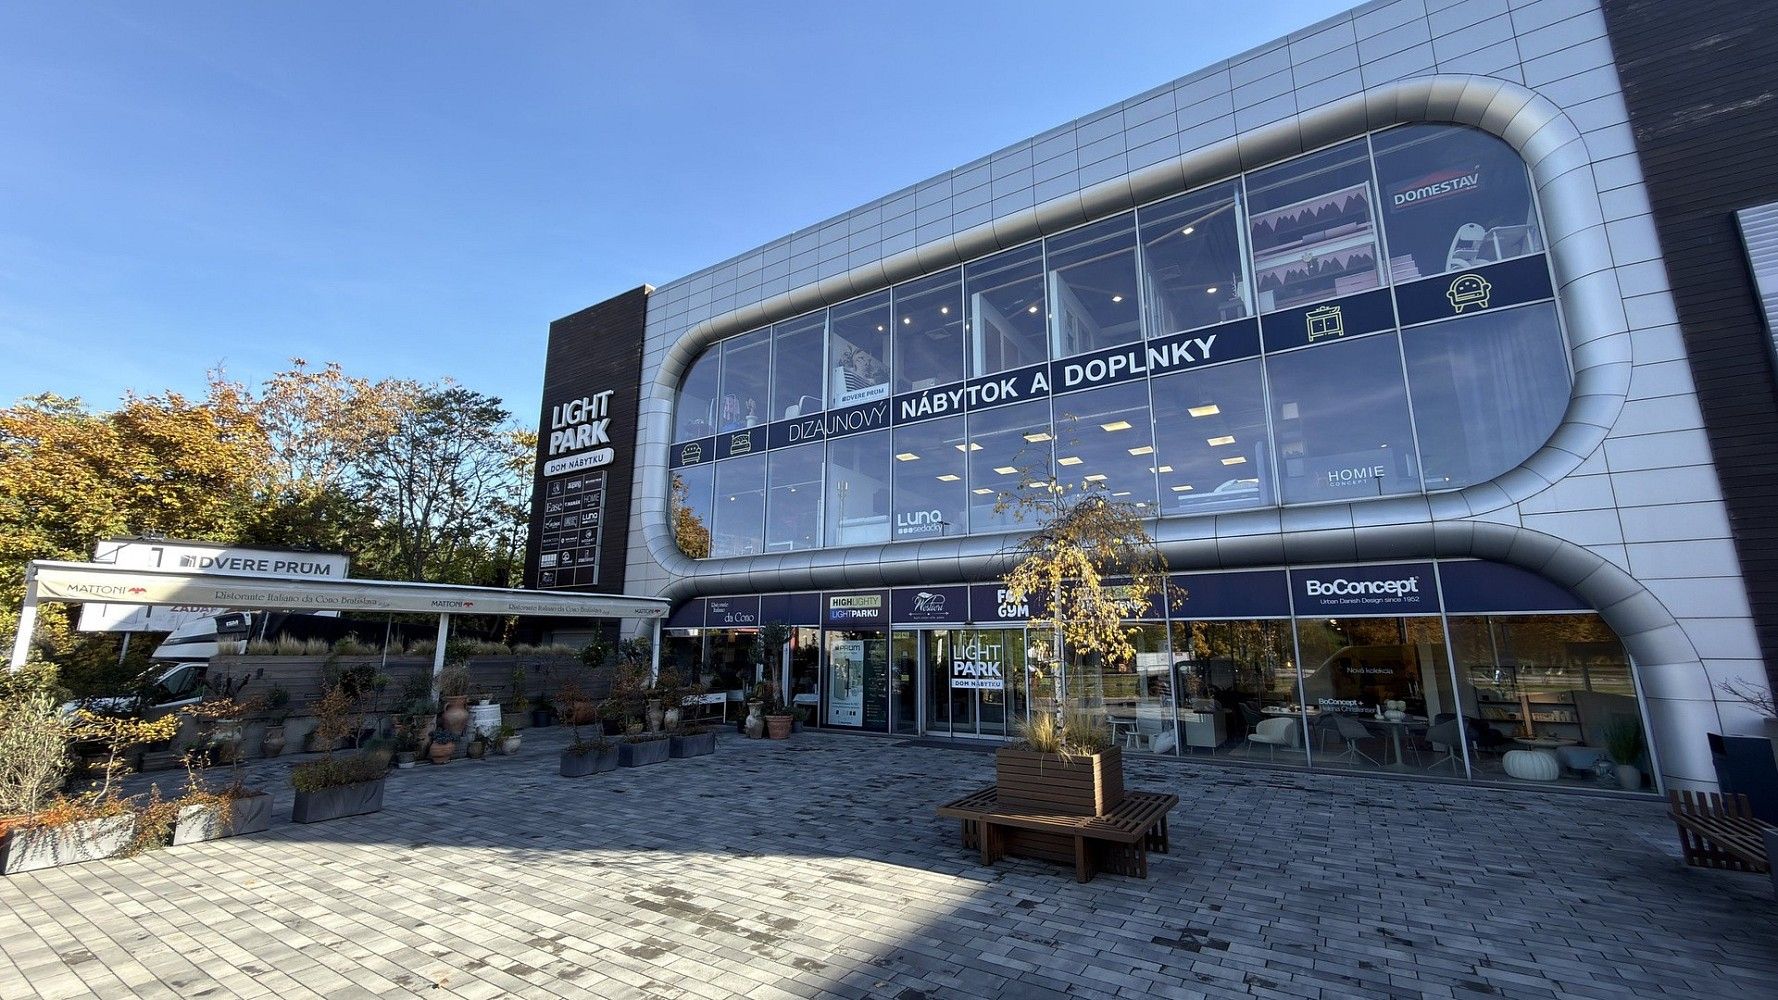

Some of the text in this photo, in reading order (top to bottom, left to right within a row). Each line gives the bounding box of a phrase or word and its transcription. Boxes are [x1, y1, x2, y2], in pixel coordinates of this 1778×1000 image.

[789, 334, 1217, 441] DIZAJNOVÝ NÁBYTOK A DOPLNKY
[552, 389, 614, 430] LIGHT
[549, 418, 610, 455] PARK
[550, 454, 604, 473] DOM NÁBYTKU
[1328, 465, 1385, 481] HOMIE
[897, 509, 942, 527] Luna
[199, 557, 331, 576] DVERE PRÜM
[67, 584, 126, 595] MATTONI
[1306, 577, 1419, 596] BoConcept
[214, 590, 266, 602] Ristorante
[832, 597, 878, 607] HIGHLIGHTY
[1361, 597, 1383, 605] Design
[431, 600, 463, 608] MATTONI
[831, 610, 878, 618] LIGHTPARKU
[997, 605, 1030, 618] GYM
[953, 645, 1001, 660] LIGHT
[953, 662, 1001, 676] PARK
[1318, 698, 1357, 706] BoConcept
